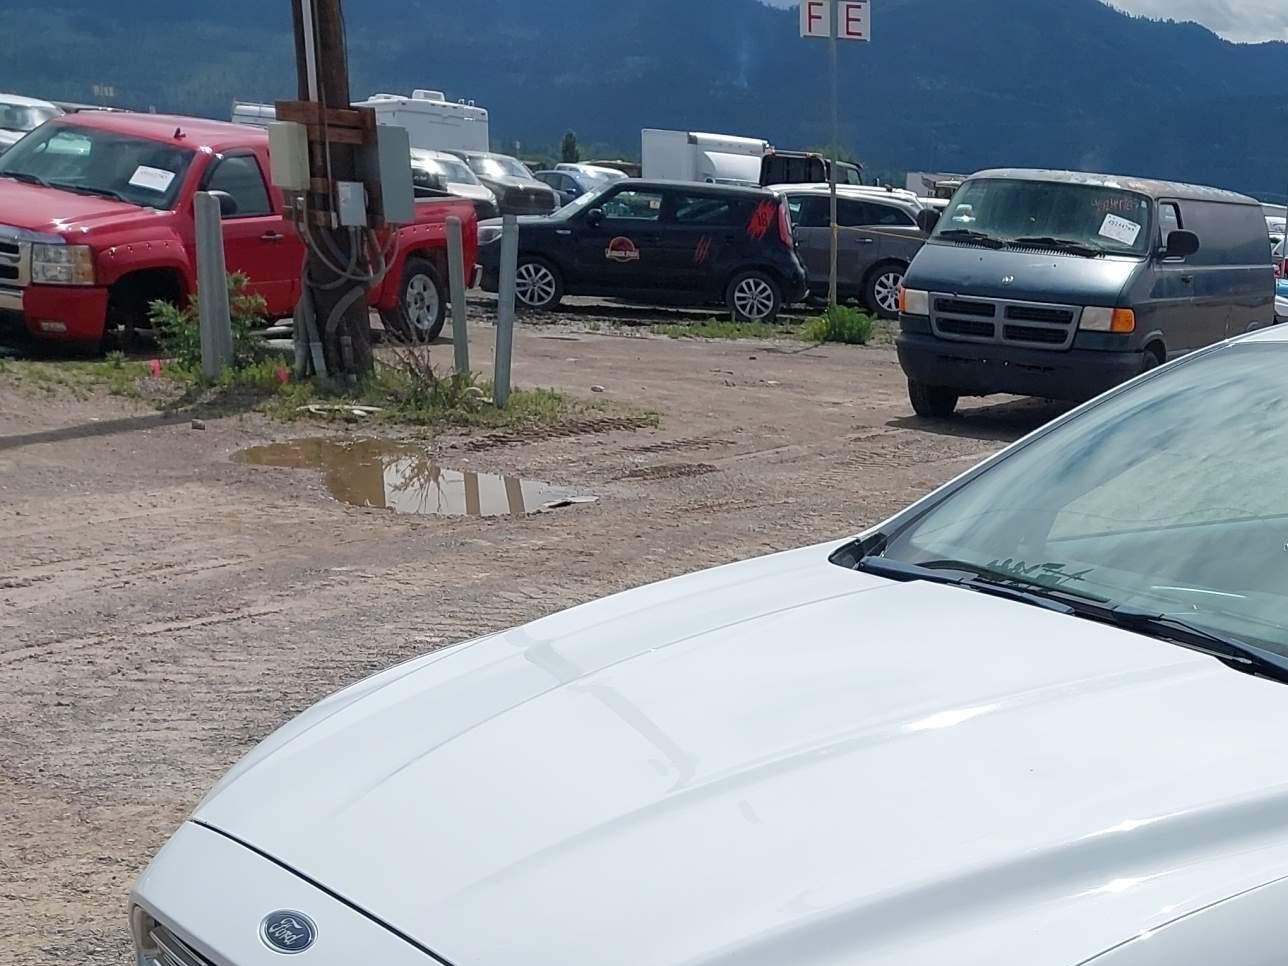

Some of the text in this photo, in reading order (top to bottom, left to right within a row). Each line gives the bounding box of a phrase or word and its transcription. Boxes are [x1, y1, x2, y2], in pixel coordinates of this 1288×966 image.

[808, 1, 862, 37] F E
[268, 917, 305, 946] Ford
